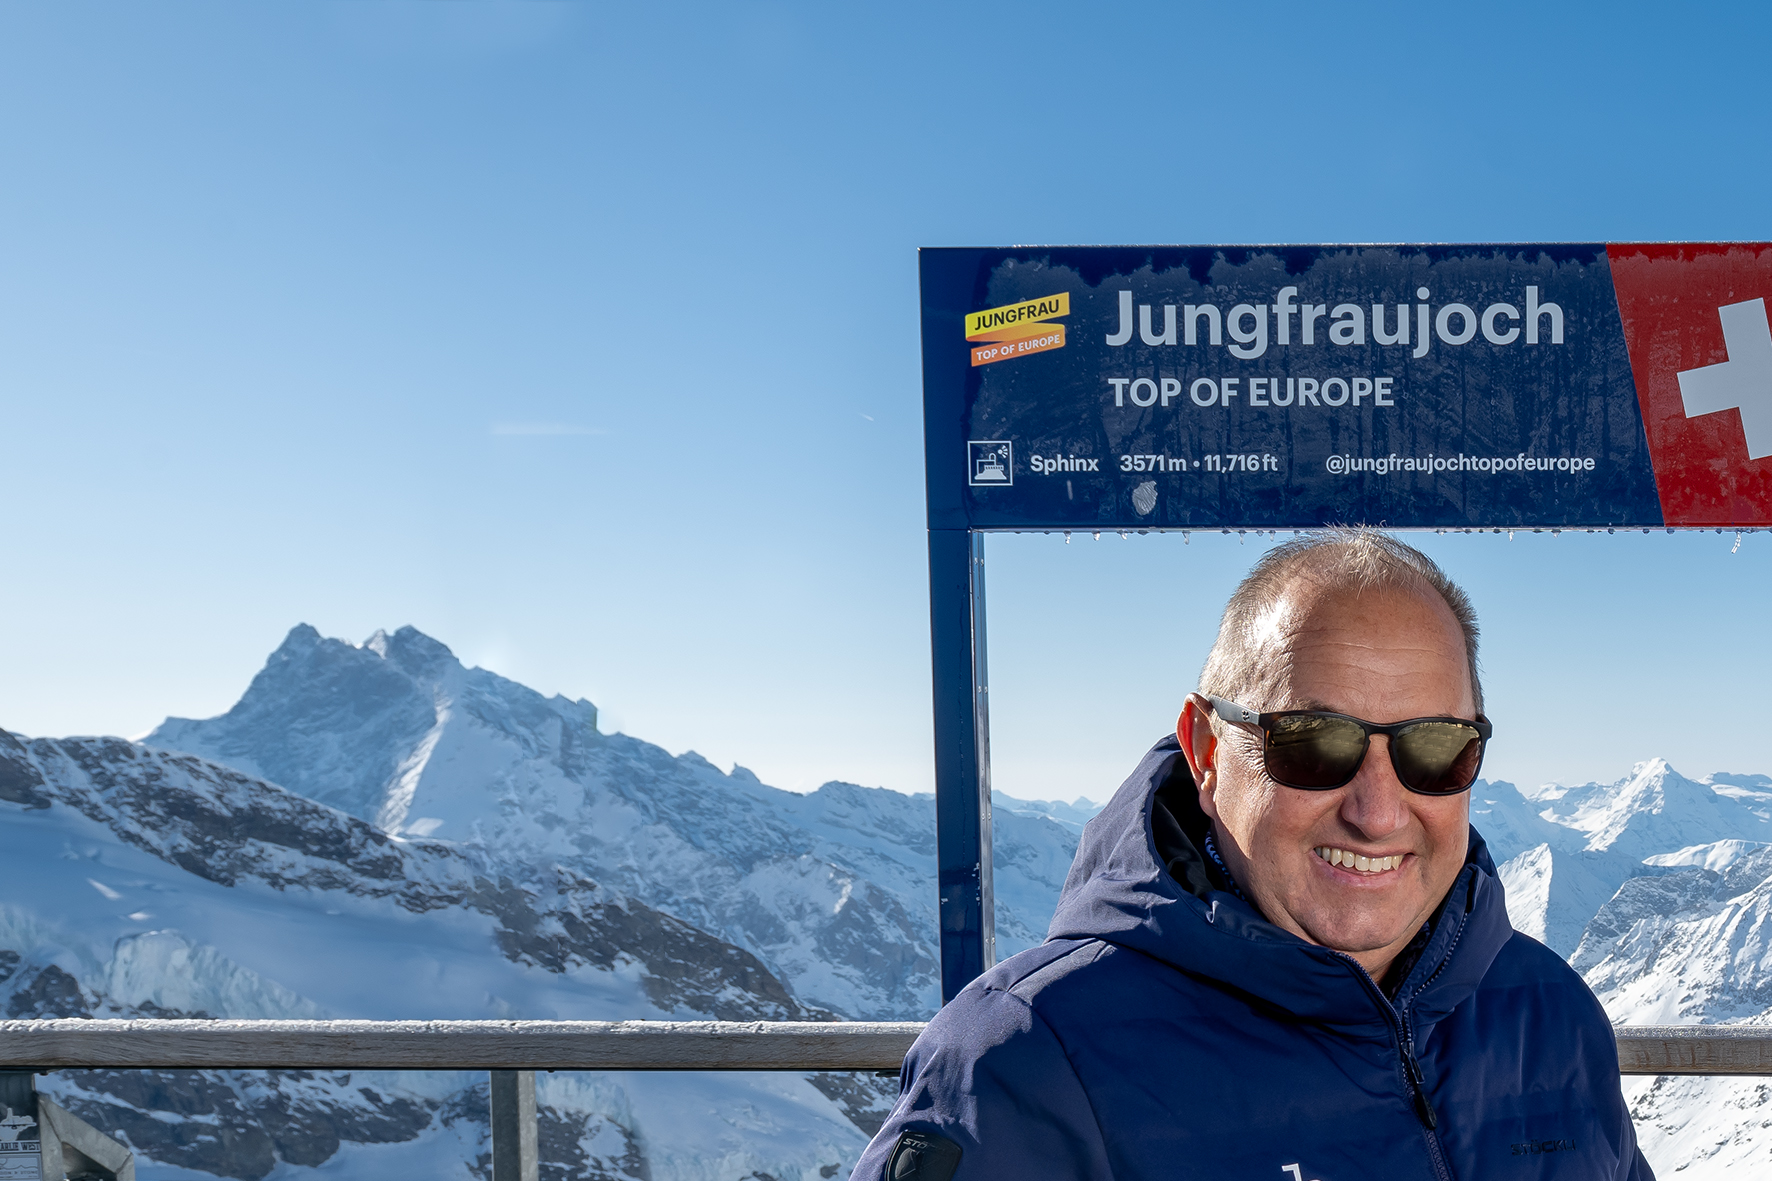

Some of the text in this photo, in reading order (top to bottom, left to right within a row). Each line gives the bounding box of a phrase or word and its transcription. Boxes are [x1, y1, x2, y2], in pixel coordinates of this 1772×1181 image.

[974, 299, 1060, 331] JUNGFRAU
[1105, 285, 1565, 359] Jungfraujoch
[976, 334, 1060, 361] TOP OF EUROPE
[1108, 377, 1394, 407] TOP OF EUROPE
[1030, 454, 1099, 476] Sphinx
[1326, 453, 1595, 475] @jungfraujochtopofeurope
[1510, 1138, 1577, 1156] STÖCKLI
